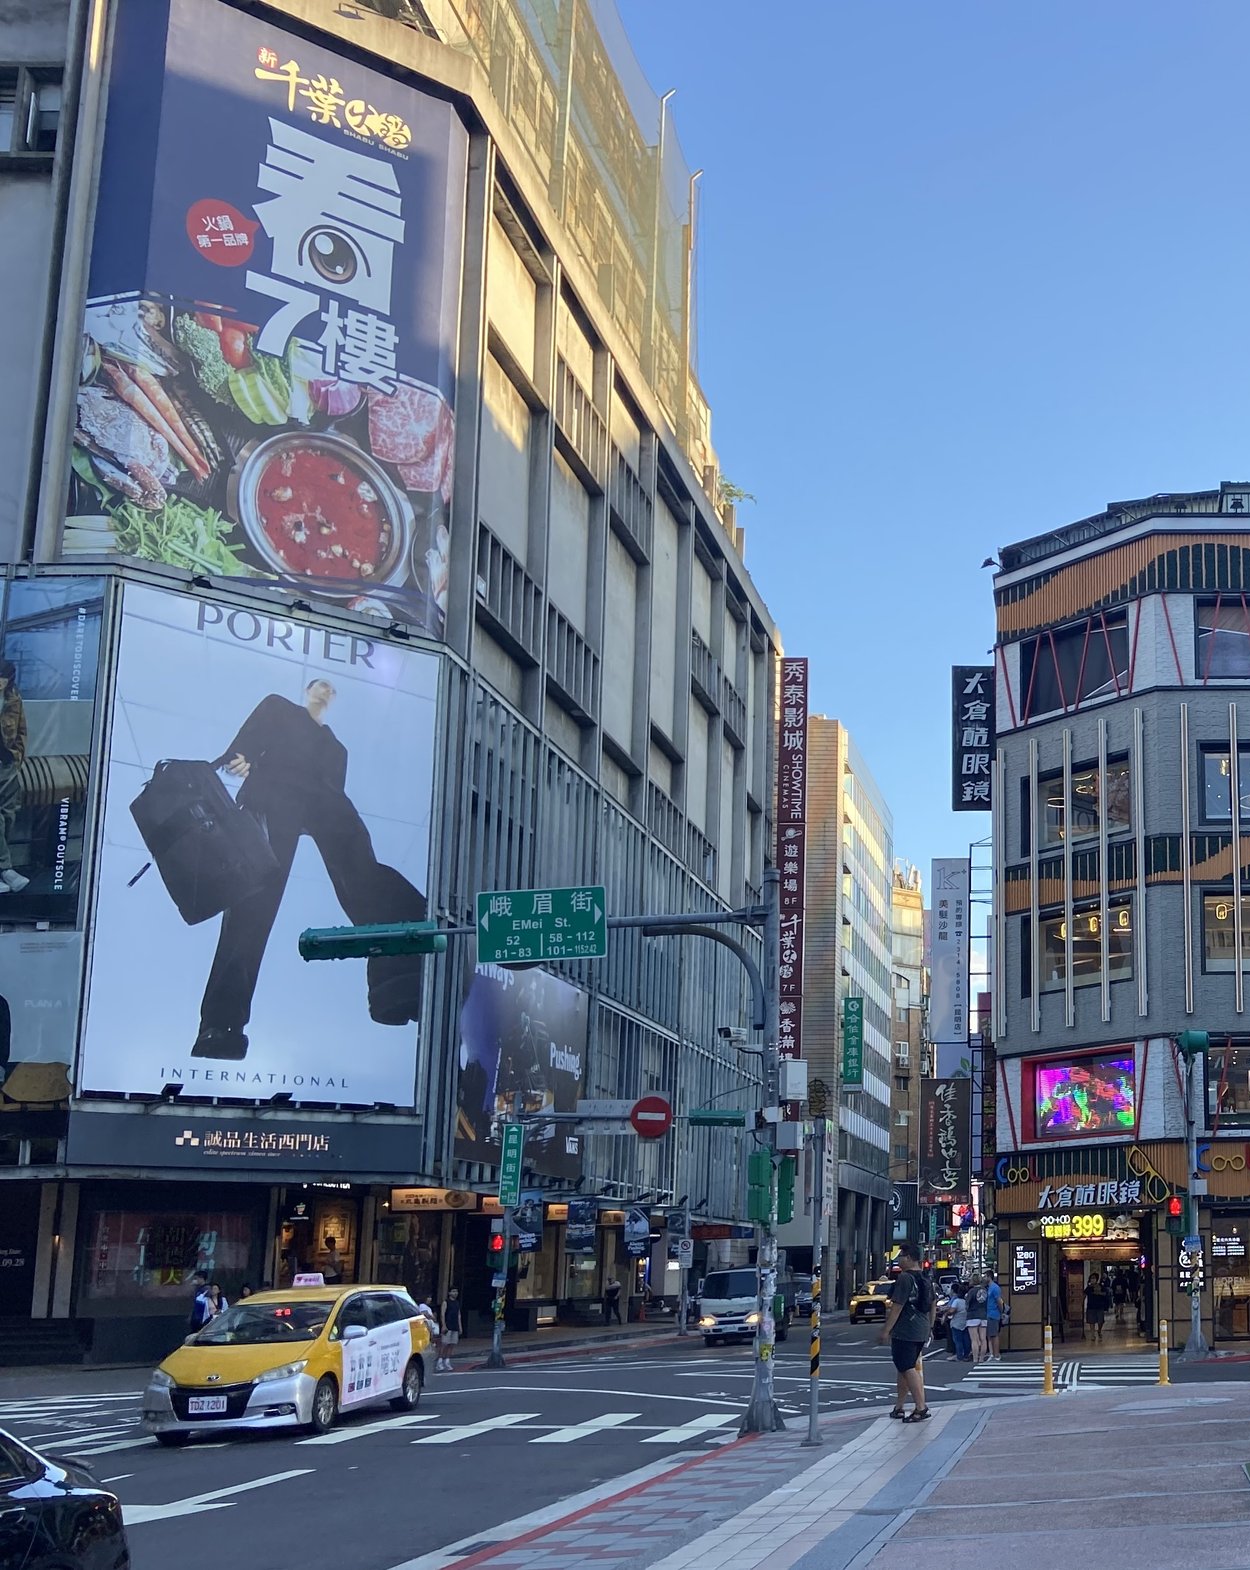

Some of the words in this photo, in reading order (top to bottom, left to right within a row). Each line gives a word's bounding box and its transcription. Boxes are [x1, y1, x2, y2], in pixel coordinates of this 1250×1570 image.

[257, 48, 278, 68] 新
[343, 129, 375, 146] SHABU
[378, 144, 409, 161] SHABU
[201, 214, 235, 232] 火鍋
[196, 232, 250, 248] 第一品牌
[197, 601, 375, 670] PORTER
[783, 661, 805, 752] 秀泰影城
[962, 672, 991, 803] 大倉酷眼鏡
[782, 764, 790, 810] CINEMAS
[790, 753, 803, 819] SHOWTIME
[53, 844, 66, 891] OUTSOLE
[783, 844, 799, 892] 遊樂場
[490, 890, 593, 917] 峨眉街
[512, 919, 543, 931] EMei
[554, 916, 571, 928] St.
[506, 935, 521, 946] 52
[160, 1067, 349, 1088] INTERNATIONAL
[203, 1130, 331, 1151] 誠品生活西門店
[506, 1134, 518, 1173] 昆明街
[1038, 1180, 1141, 1209] 大倉酷眼鏡
[1072, 1214, 1104, 1237] 399
[1016, 1251, 1035, 1260] 1280
